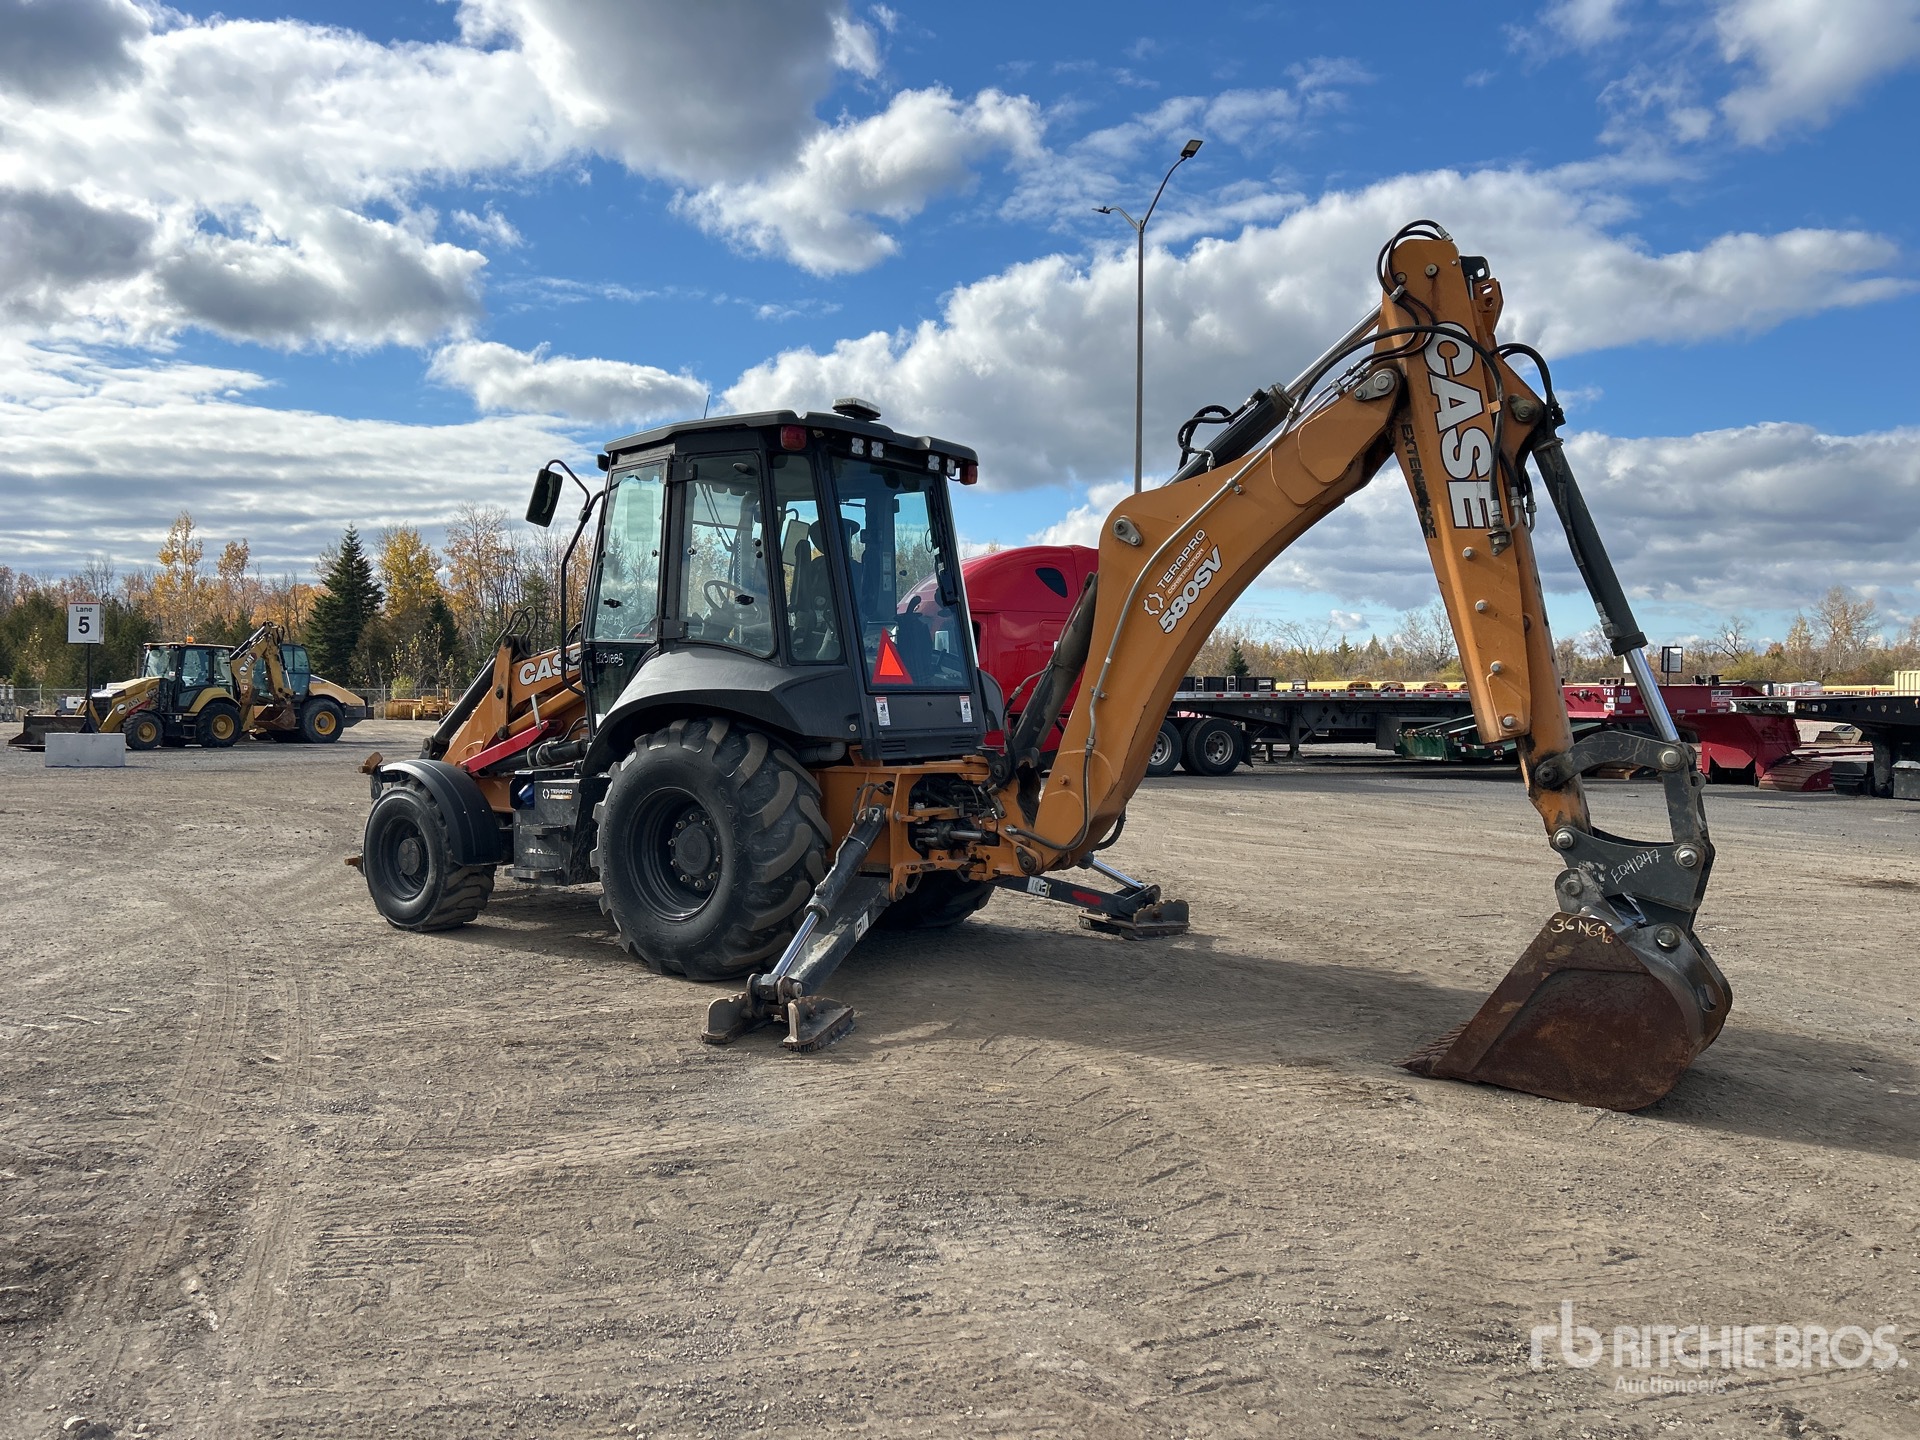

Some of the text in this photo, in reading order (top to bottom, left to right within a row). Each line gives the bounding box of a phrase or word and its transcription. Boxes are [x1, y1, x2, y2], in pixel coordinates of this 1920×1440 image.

[1424, 321, 1491, 529] CASE
[1157, 529, 1206, 588] TERAPRO
[1167, 548, 1205, 594] CONSTRUCTION
[1159, 545, 1222, 634] 580SV
[78, 616, 90, 634] 5
[1603, 688, 1614, 696] T21
[1610, 848, 1661, 885] EQ41247
